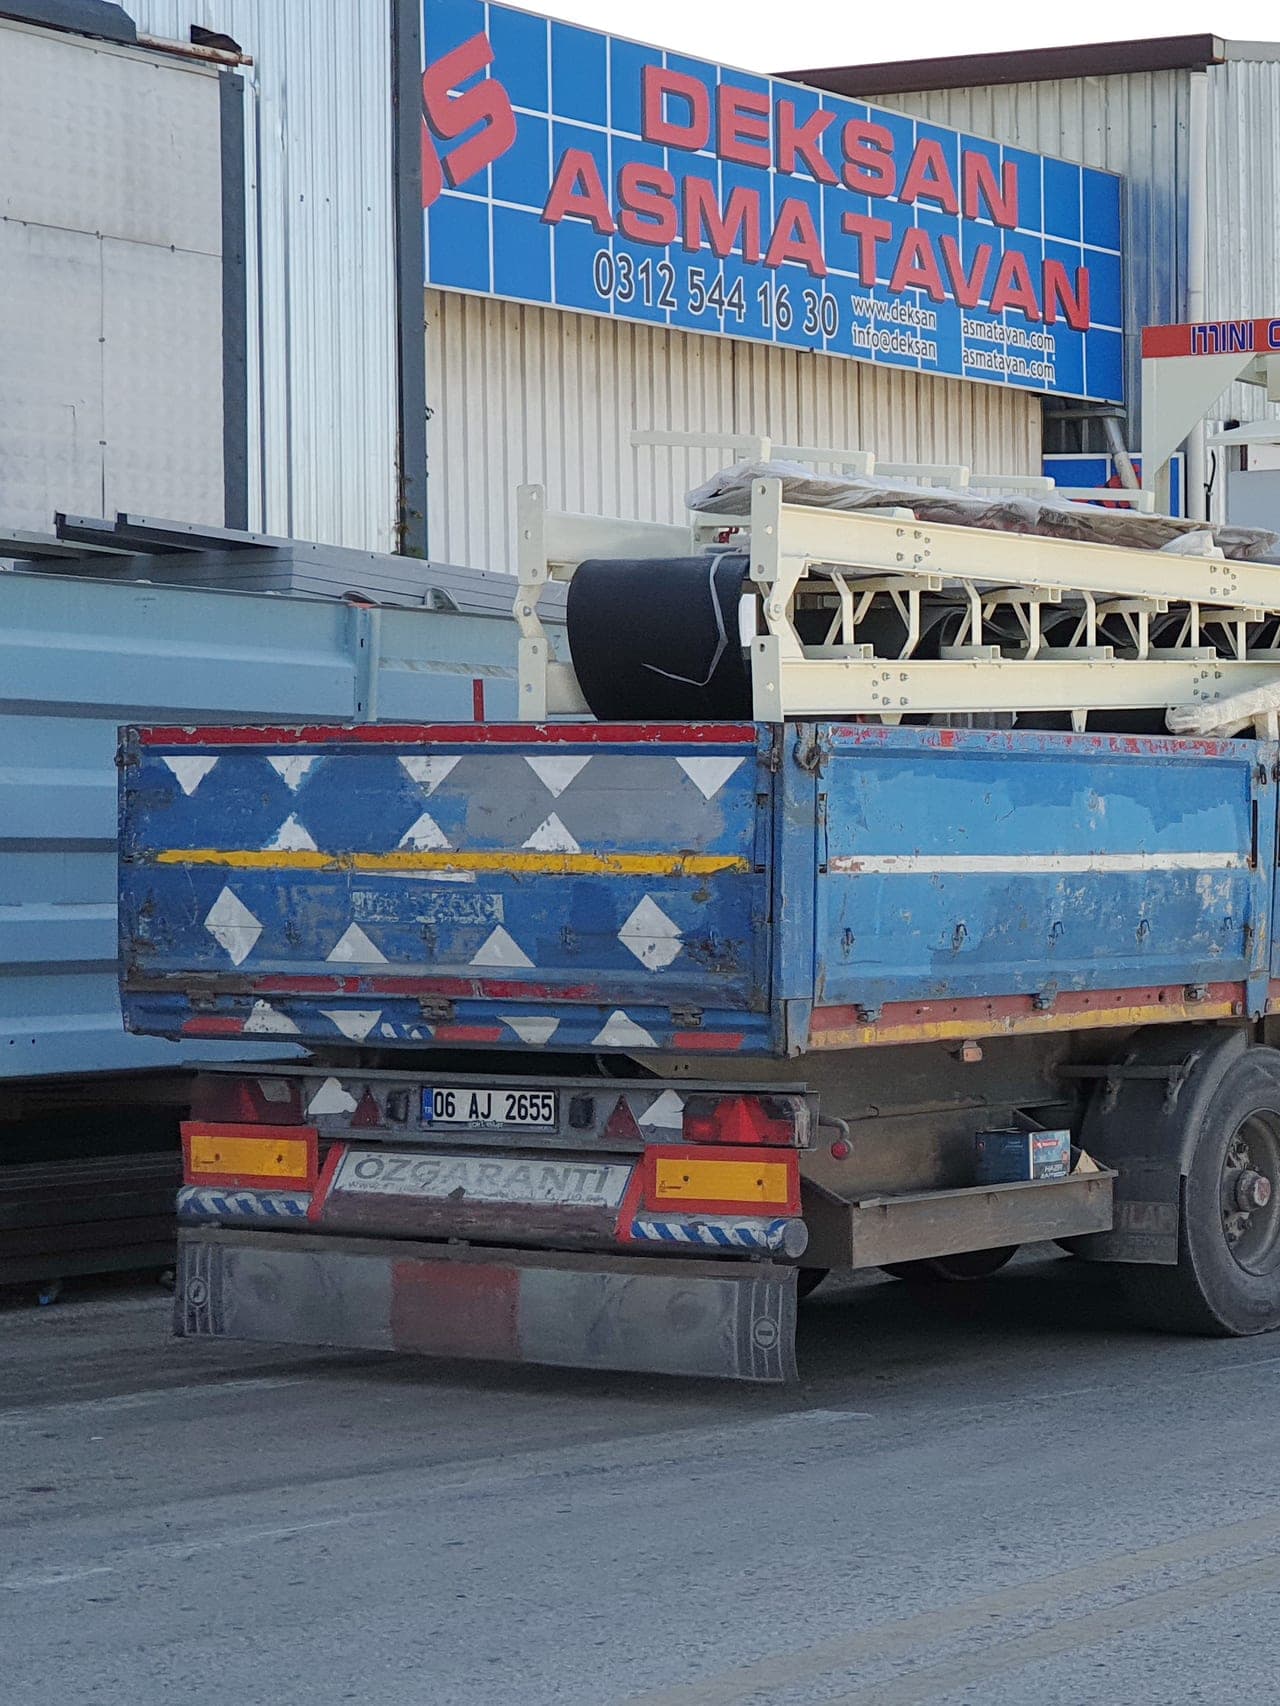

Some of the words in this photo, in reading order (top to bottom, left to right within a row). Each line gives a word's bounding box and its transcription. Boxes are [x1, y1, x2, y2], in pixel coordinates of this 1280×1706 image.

[641, 64, 1017, 229] DEKSAN
[540, 147, 827, 278] ASMA
[841, 211, 1090, 331] TAVAN
[593, 249, 677, 310] 0312
[687, 266, 746, 323] 544
[757, 281, 792, 331] 16
[803, 289, 839, 339] 30
[851, 295, 937, 331] www.deksan
[962, 317, 1055, 353] asmatavan.com
[1191, 320, 1255, 355] MINI
[852, 325, 937, 359] info@deksan
[962, 347, 1055, 382] asmatavan.com
[434, 1091, 456, 1118] 06
[468, 1092, 492, 1120] AJ
[505, 1094, 553, 1122] 2655
